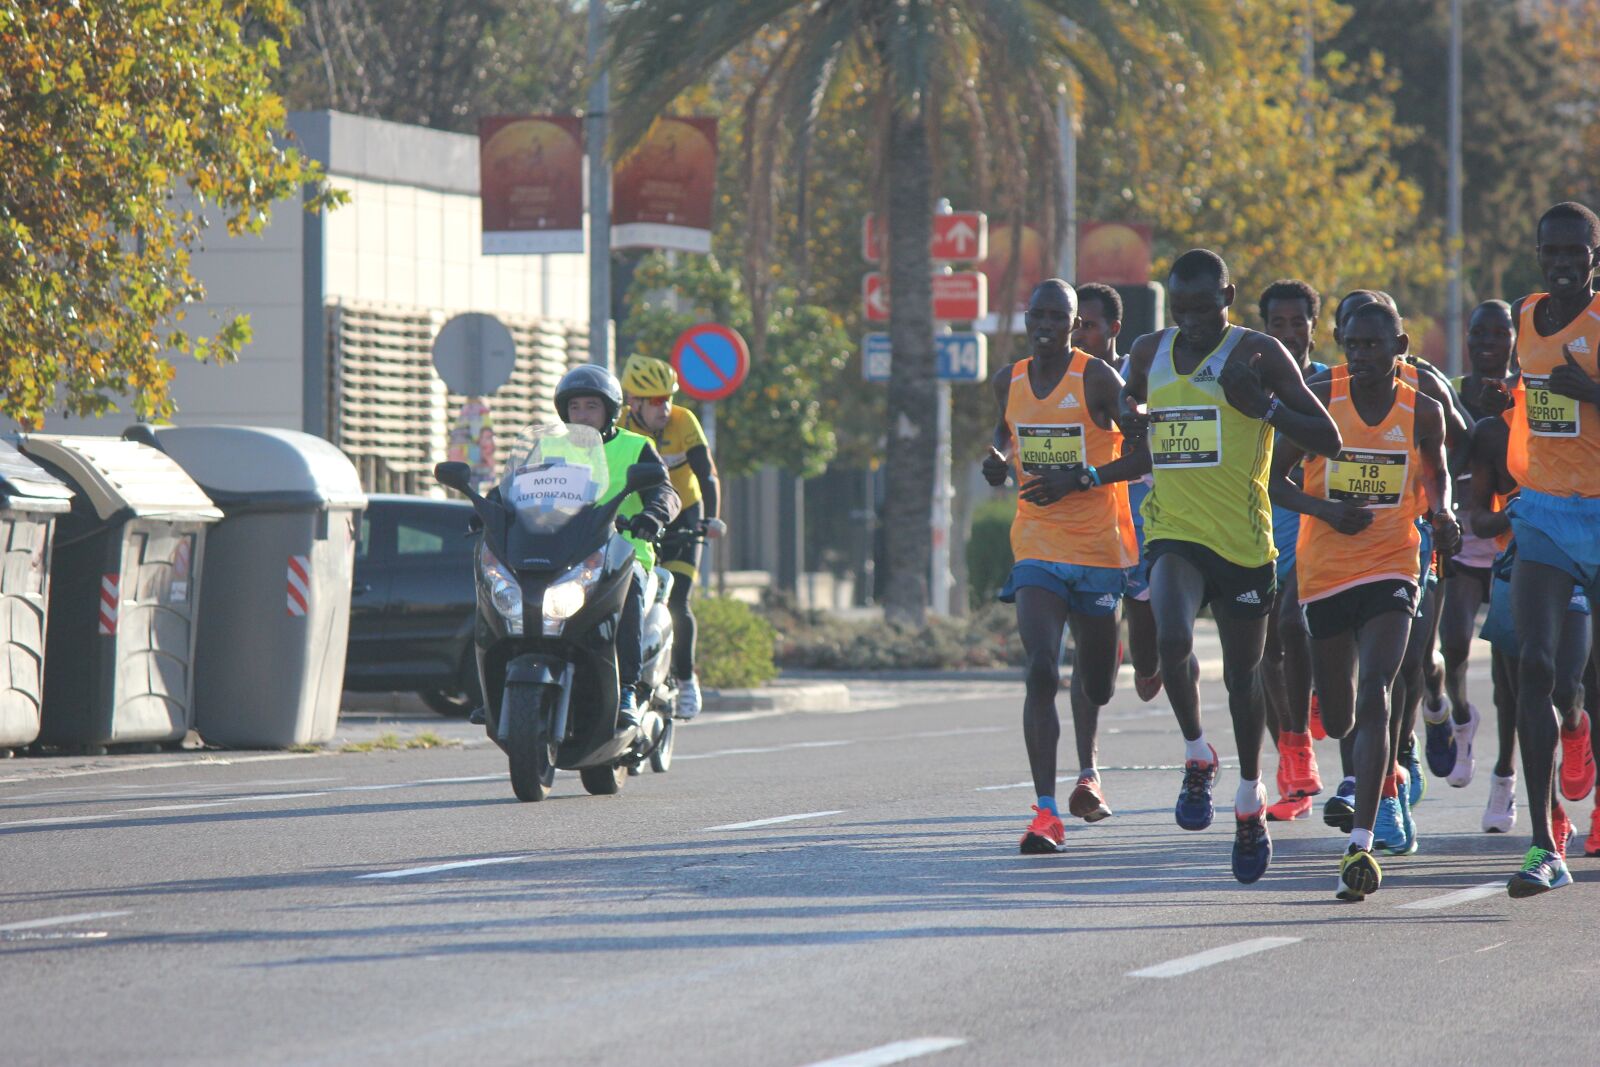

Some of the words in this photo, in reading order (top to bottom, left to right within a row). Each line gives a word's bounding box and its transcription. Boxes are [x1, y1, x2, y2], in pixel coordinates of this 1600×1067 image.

[945, 341, 977, 374] 14
[1533, 390, 1549, 406] 16
[1169, 423, 1188, 437] 17
[1043, 438, 1052, 450] 4
[1161, 437, 1200, 452] KIPTOO
[1023, 450, 1078, 463] KENDAGOR
[1360, 464, 1380, 478] 18
[533, 477, 568, 486] MOTO
[1347, 478, 1387, 494] TARUS
[515, 491, 583, 502] AUTORIZADA
